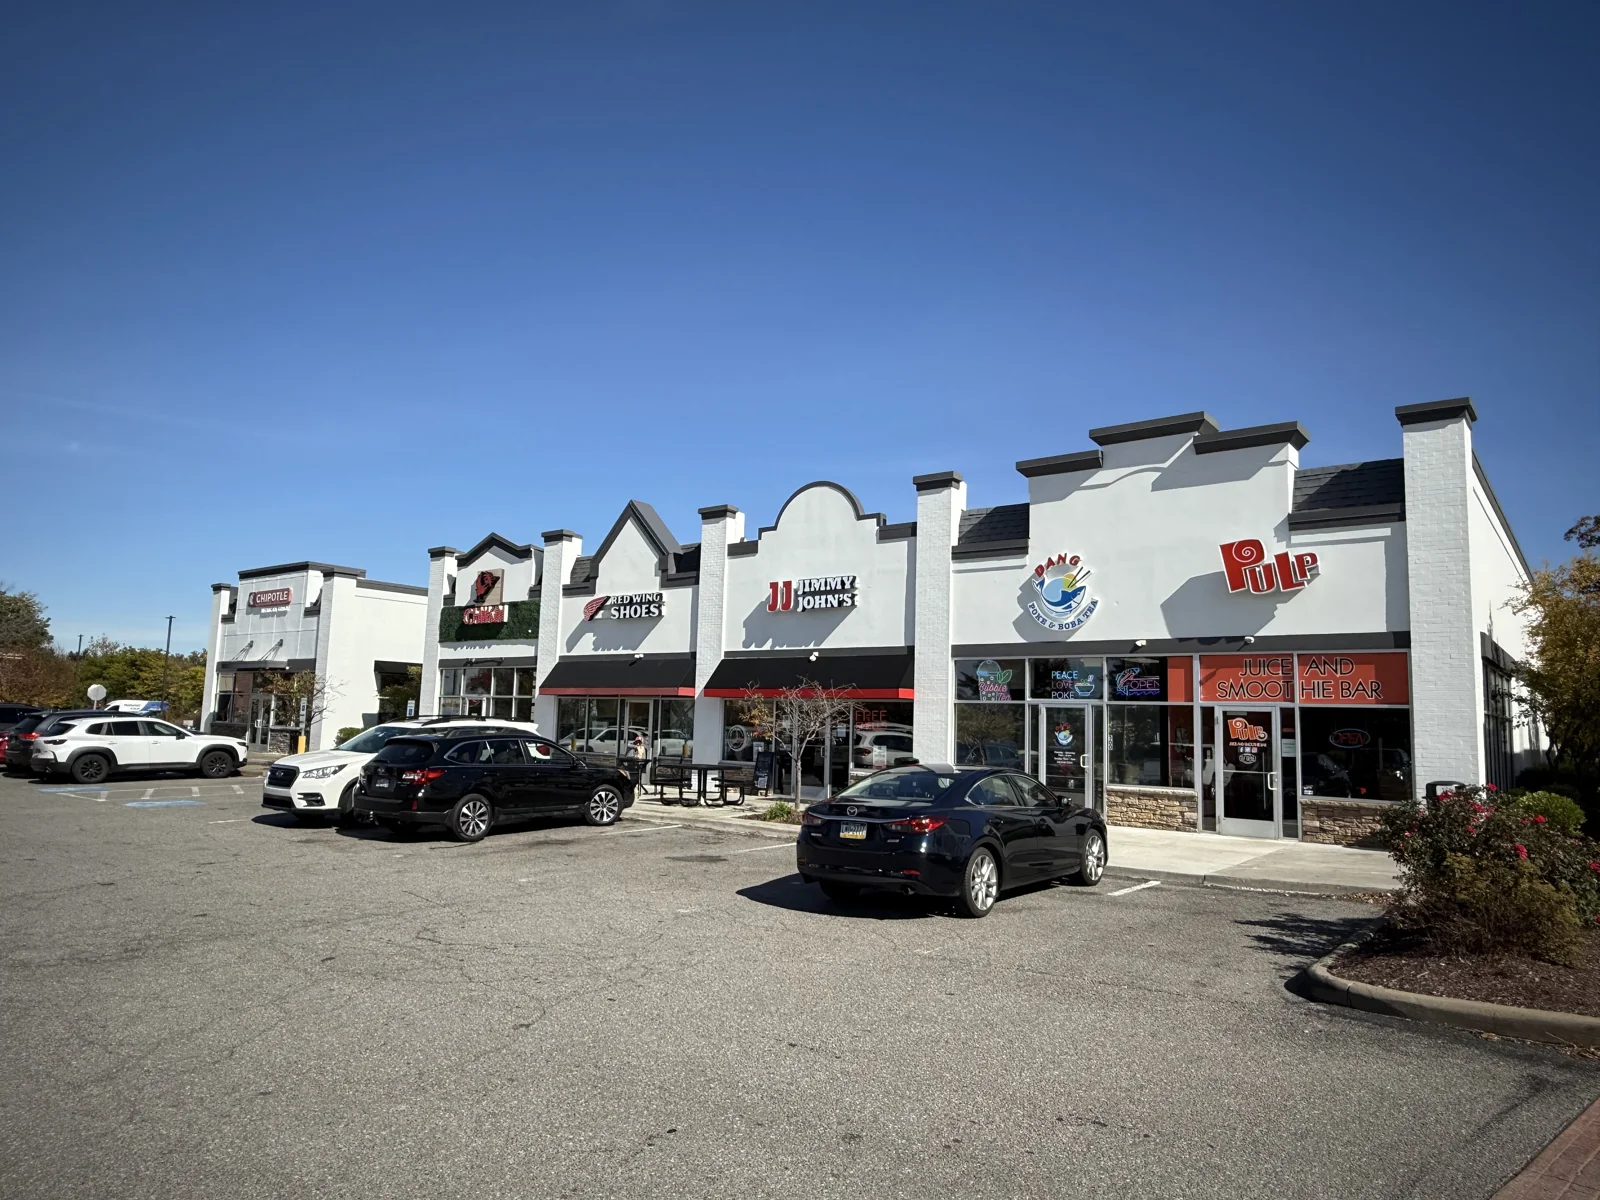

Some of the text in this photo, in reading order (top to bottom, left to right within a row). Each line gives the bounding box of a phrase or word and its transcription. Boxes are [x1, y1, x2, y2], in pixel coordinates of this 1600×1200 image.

[1034, 552, 1080, 578] DANG
[797, 576, 853, 595] JIMMY
[256, 591, 289, 603] CHIPOTLE
[611, 592, 661, 605] RED WING
[797, 593, 853, 612] JOHN'S
[610, 603, 660, 619] SHOES
[1028, 602, 1048, 626] POKE
[1058, 617, 1084, 630] BOBA
[1083, 600, 1099, 619] TEA
[1239, 656, 1355, 677] JUICE AND
[1051, 670, 1079, 680] PEACE
[978, 681, 1008, 692] Bubble
[1051, 681, 1074, 690] LOVE
[1339, 678, 1384, 699] BAR
[1051, 691, 1075, 700] POKE
